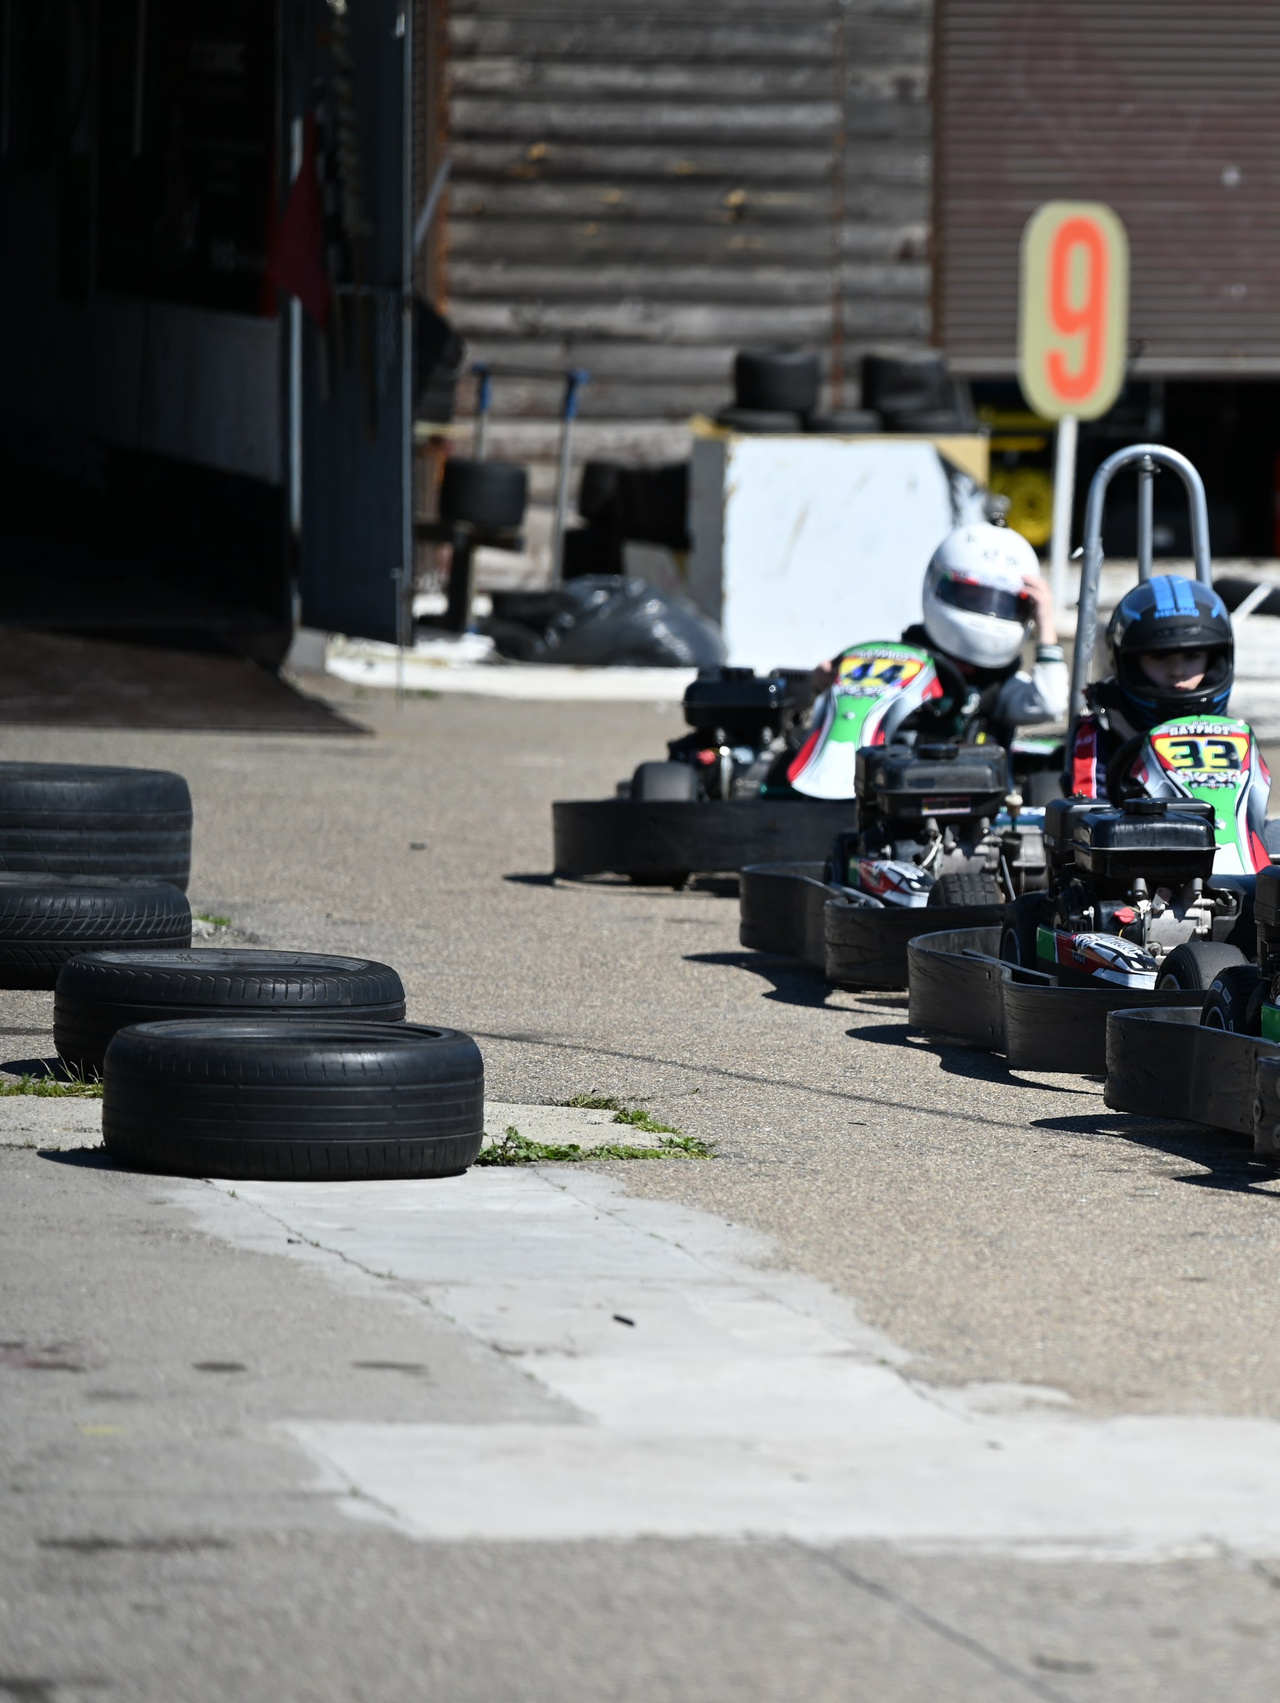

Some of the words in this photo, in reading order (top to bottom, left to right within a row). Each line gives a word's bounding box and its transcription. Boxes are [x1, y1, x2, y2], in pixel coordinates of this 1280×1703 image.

[1045, 217, 1108, 403] 9
[1169, 723, 1231, 736] ПАТРИОТ
[1169, 739, 1241, 769] 33
